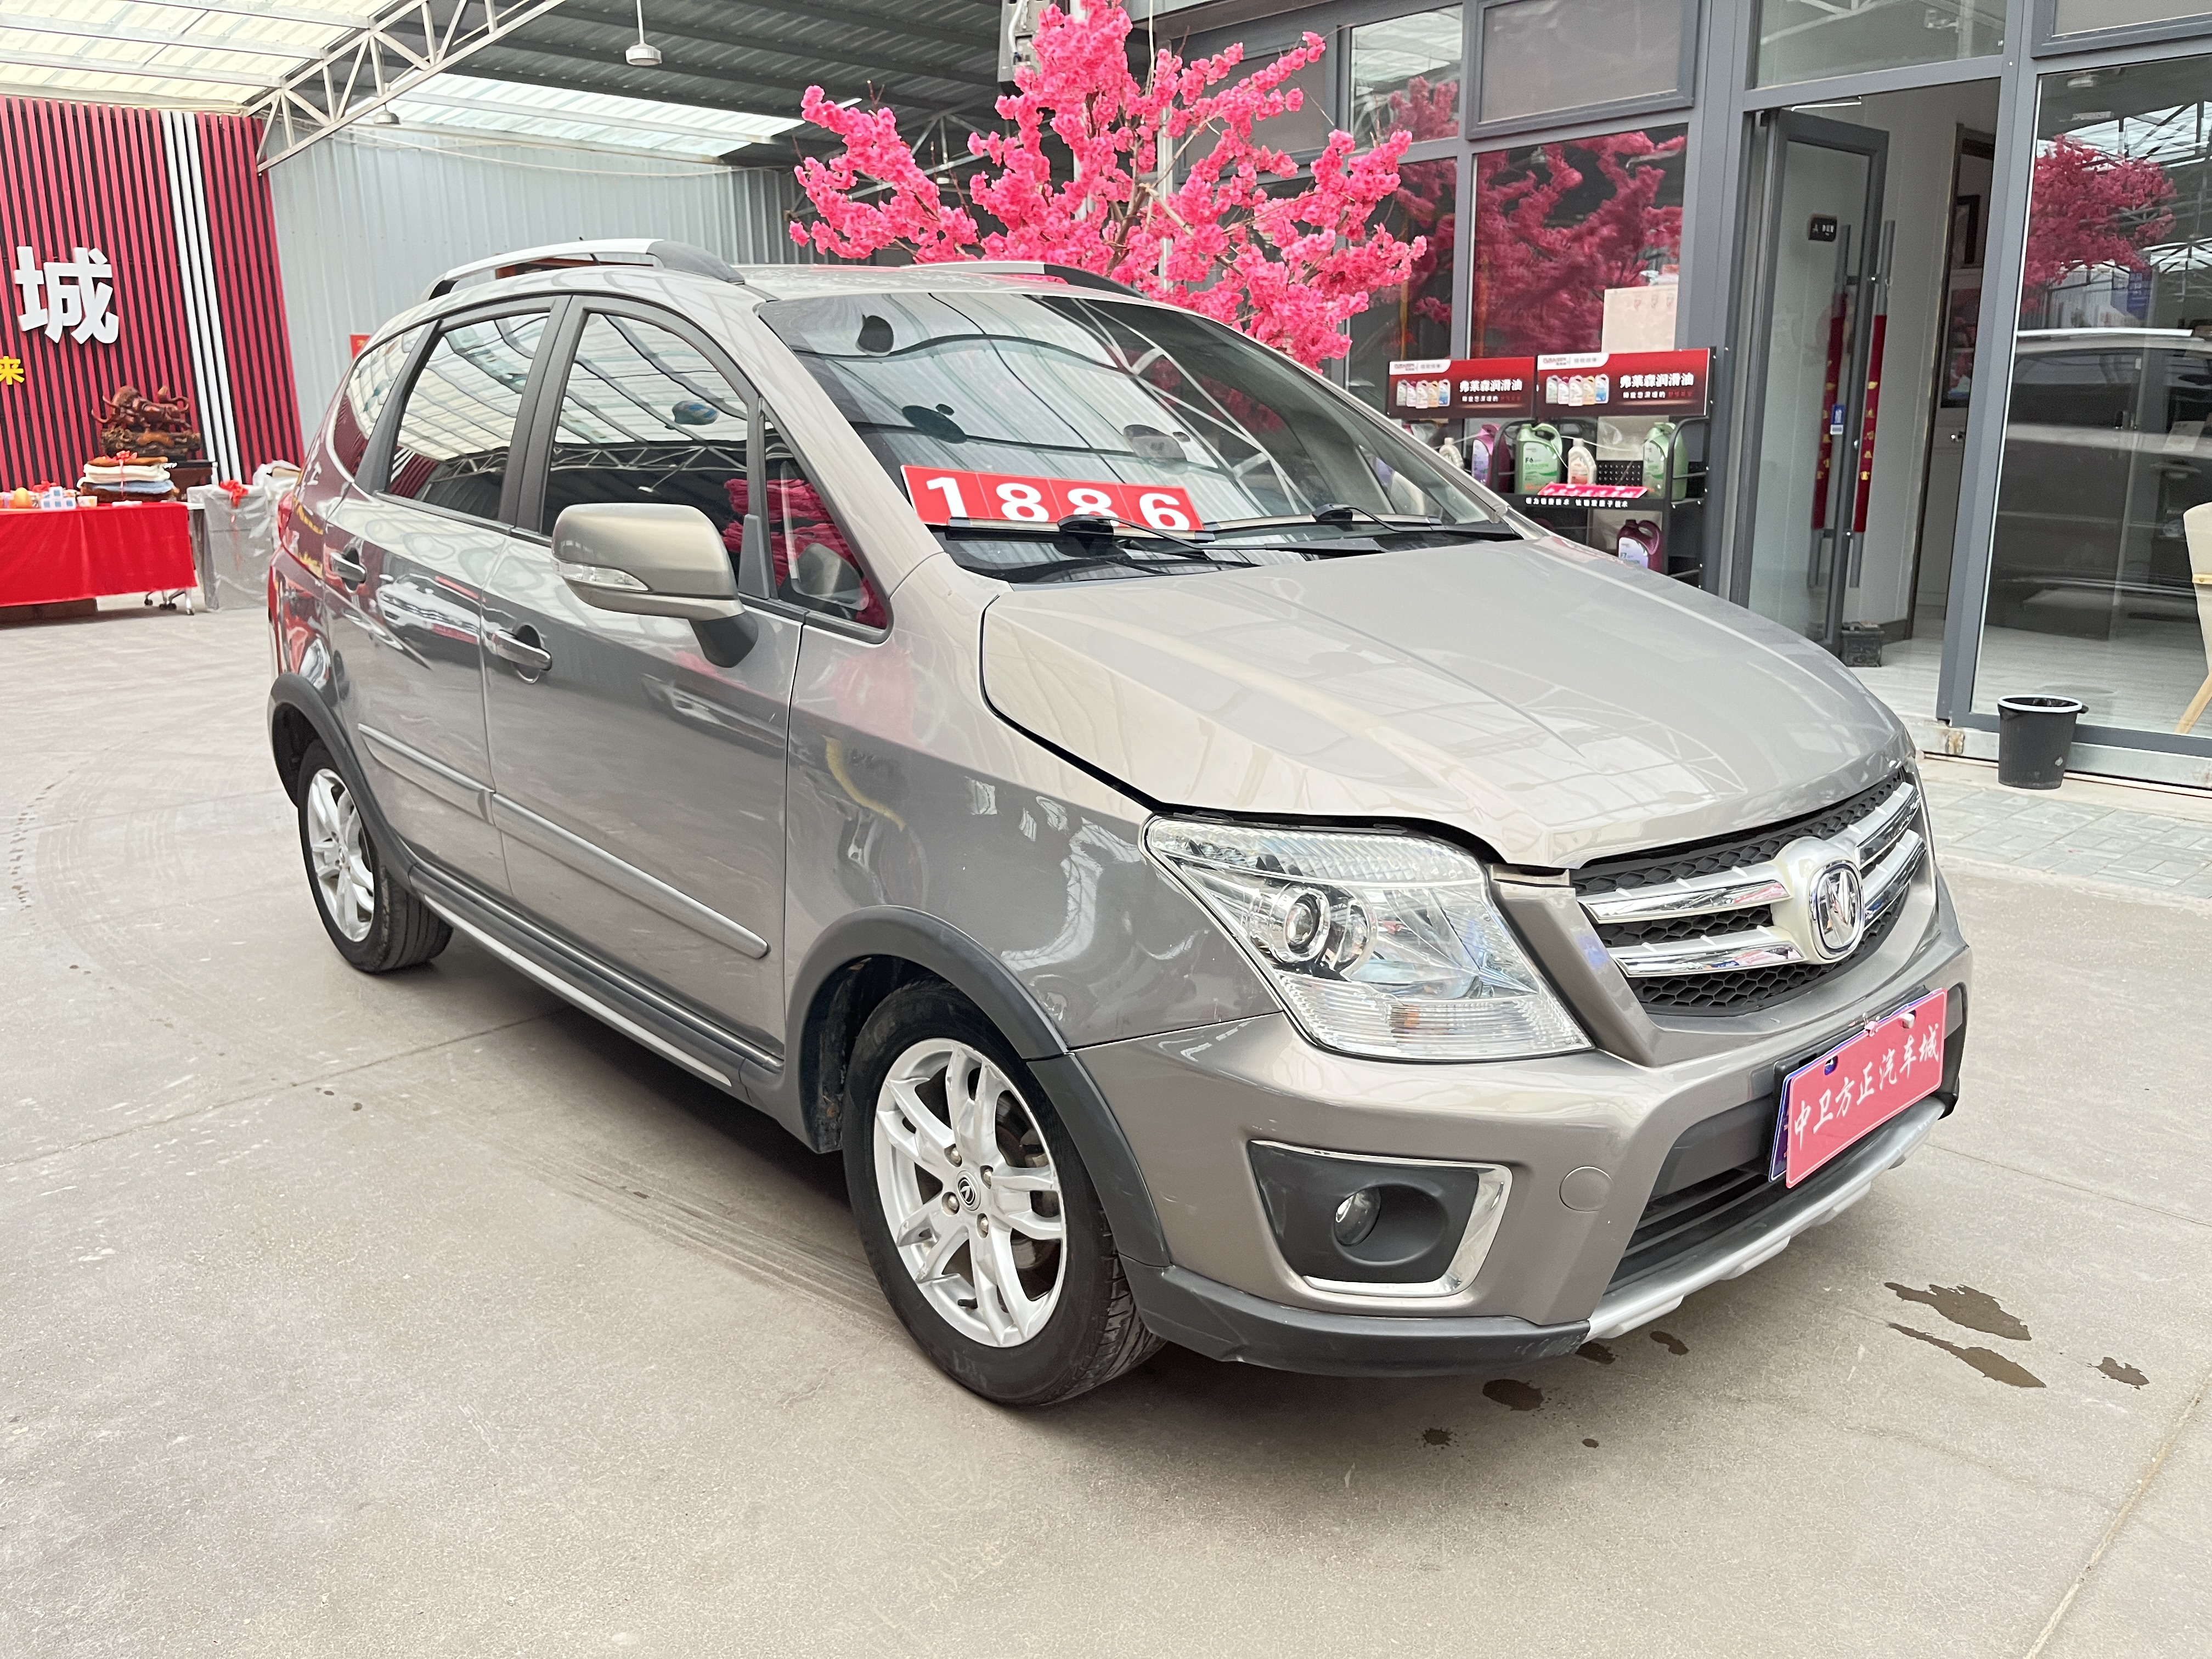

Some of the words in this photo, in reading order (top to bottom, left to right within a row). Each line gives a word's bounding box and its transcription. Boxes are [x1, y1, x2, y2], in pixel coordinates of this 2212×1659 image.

[14, 246, 119, 344] 城
[0, 356, 25, 385] 来
[926, 476, 1189, 531] 1886
[1794, 1023, 1939, 1150] 中卫方正汽车城
